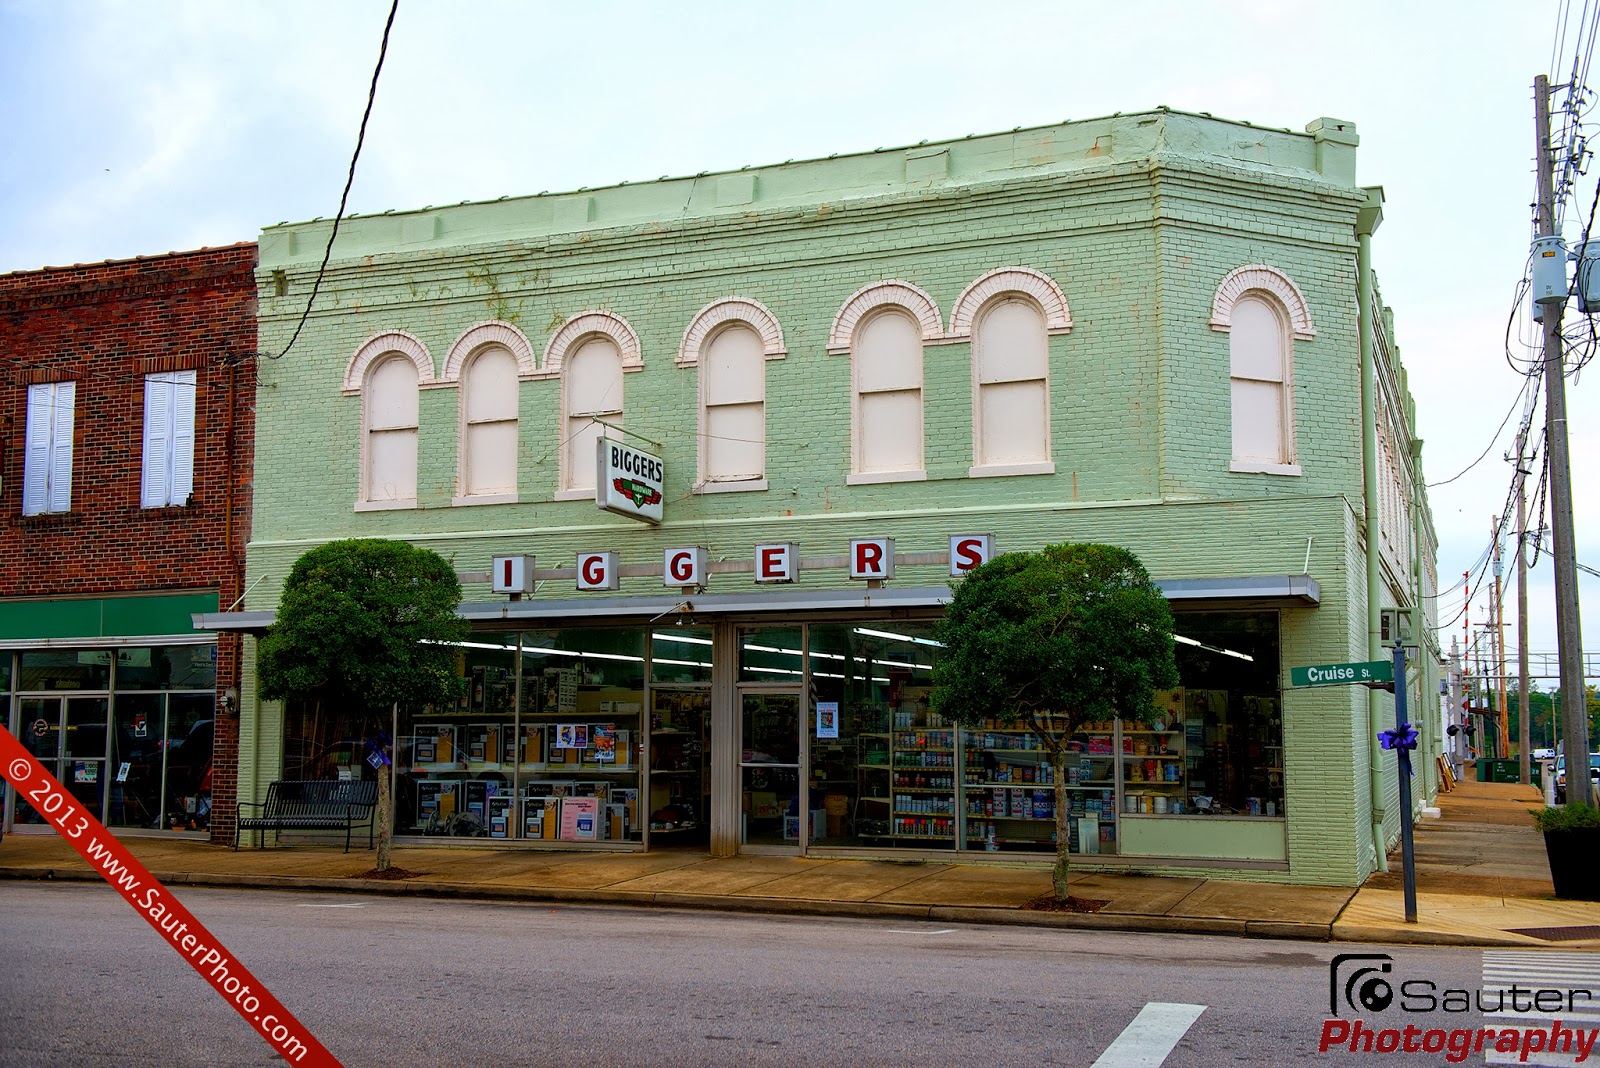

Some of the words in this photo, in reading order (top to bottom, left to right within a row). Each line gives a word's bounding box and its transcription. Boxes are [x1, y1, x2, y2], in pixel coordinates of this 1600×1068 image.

[611, 445, 663, 483] BIGGERS
[1307, 665, 1355, 682] Cruise
[1361, 668, 1371, 678] St.
